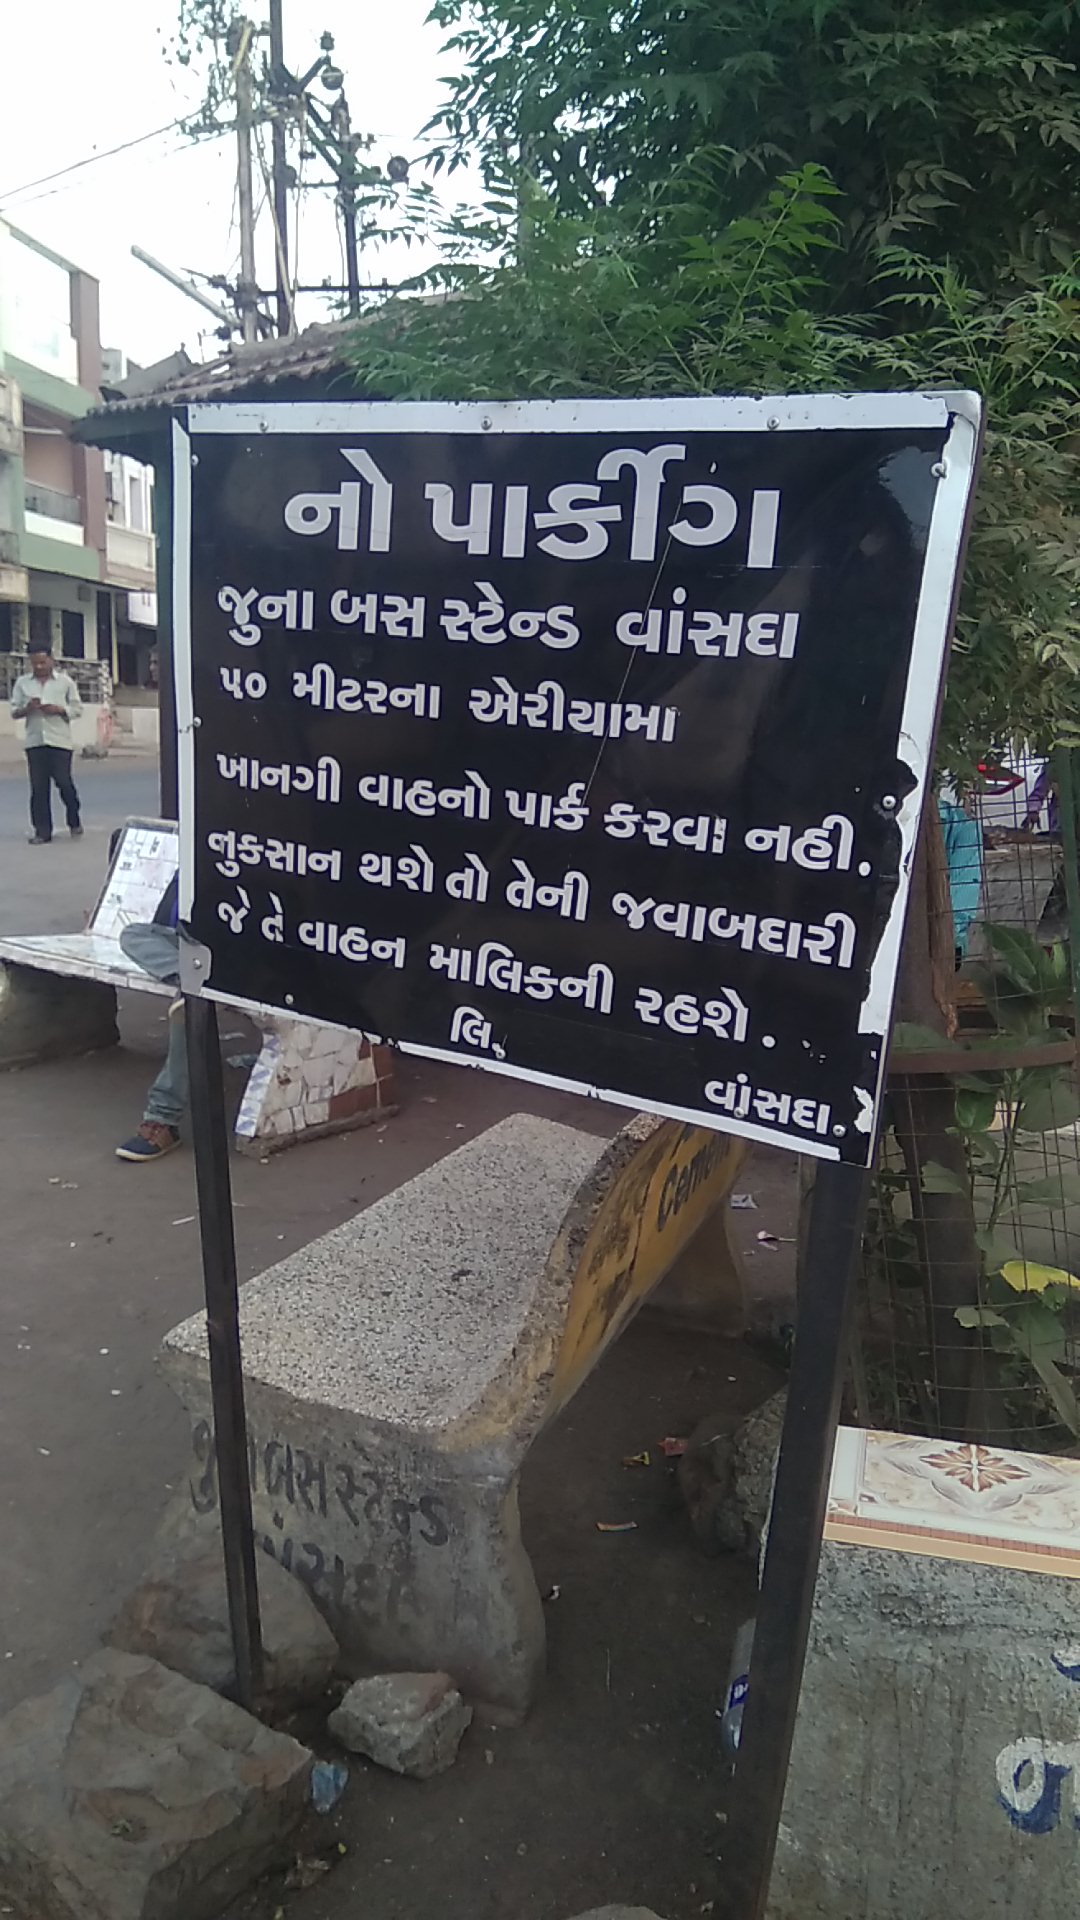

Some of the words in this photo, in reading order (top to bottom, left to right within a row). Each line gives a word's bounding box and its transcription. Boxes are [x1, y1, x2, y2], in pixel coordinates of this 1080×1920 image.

[284, 448, 393, 552] નો
[217, 585, 314, 646] જુના
[330, 589, 426, 638] બસ
[439, 581, 581, 649] સ્ટેન્ડ
[615, 586, 800, 659] વાંસદા
[292, 662, 442, 719] મીટરના
[216, 753, 342, 803] ખાનગી
[357, 769, 491, 820] વાહનો
[505, 782, 590, 831] પાર્ક
[603, 802, 728, 854] કરવા
[207, 830, 342, 881] નુકસાન
[358, 843, 434, 893] થશે
[445, 852, 490, 903] તો
[506, 858, 590, 922] તેની
[611, 892, 857, 969] જવાબદારી
[217, 885, 252, 934] જે
[261, 891, 285, 943] તે
[298, 921, 406, 969] વાહન
[429, 941, 614, 1014] માલિકની
